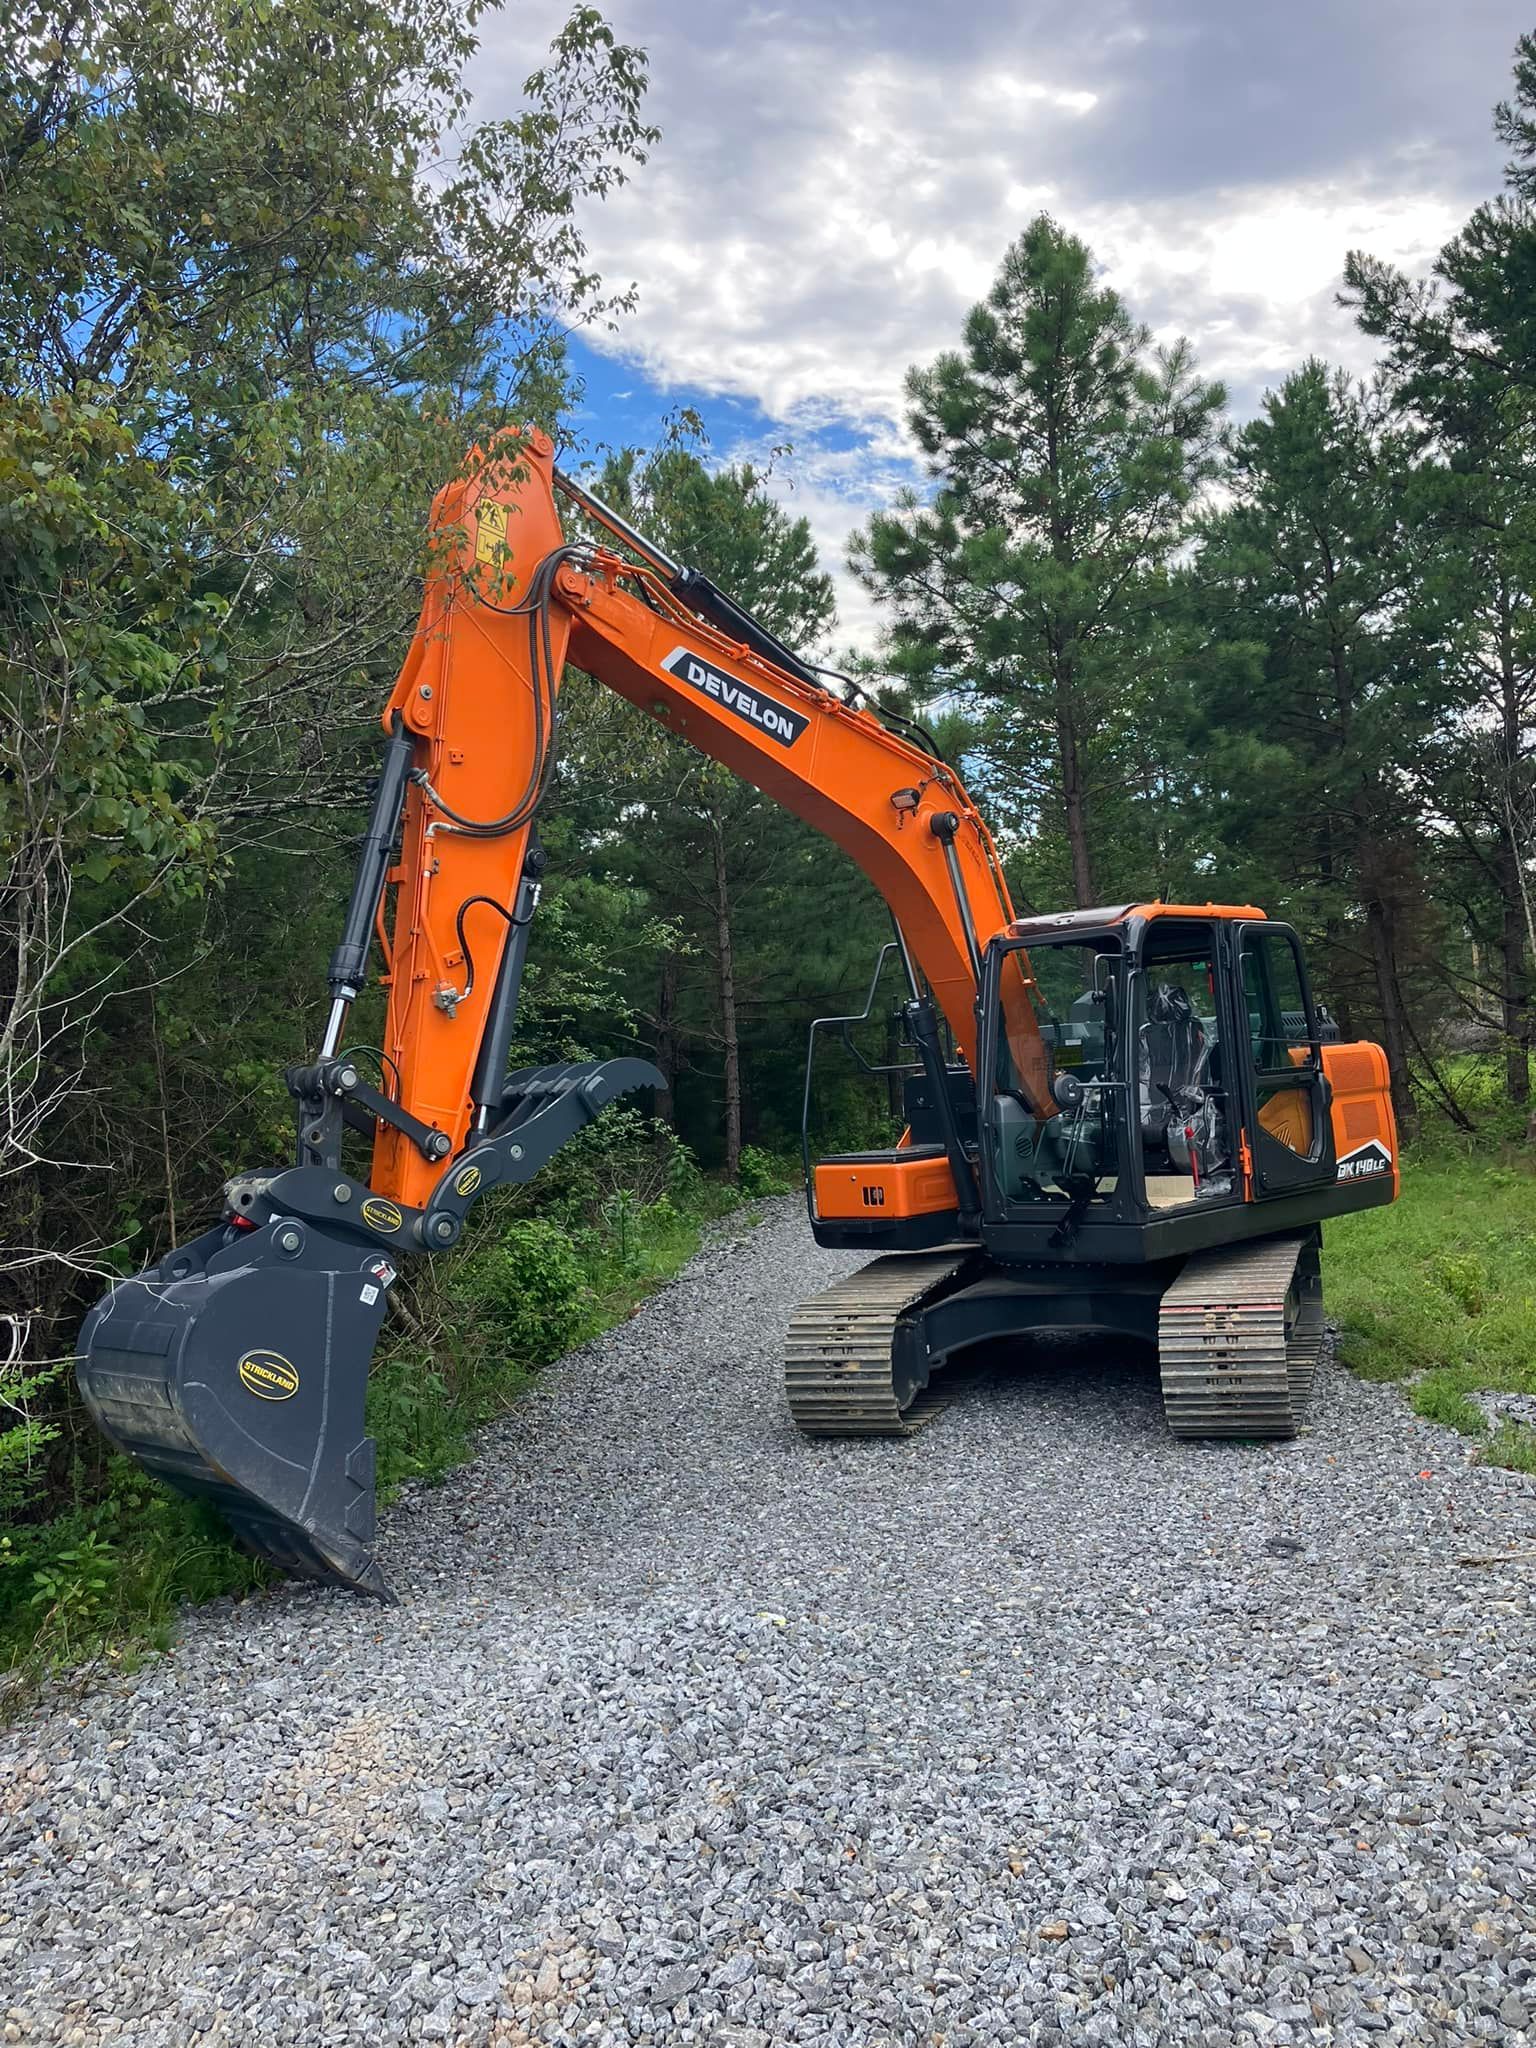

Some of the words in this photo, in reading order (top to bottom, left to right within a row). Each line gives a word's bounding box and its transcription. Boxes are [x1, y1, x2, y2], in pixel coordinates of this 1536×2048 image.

[687, 662, 794, 740] DEVELON
[366, 1205, 400, 1226] STRICKLAND
[244, 1361, 295, 1391] STRICKLAND
